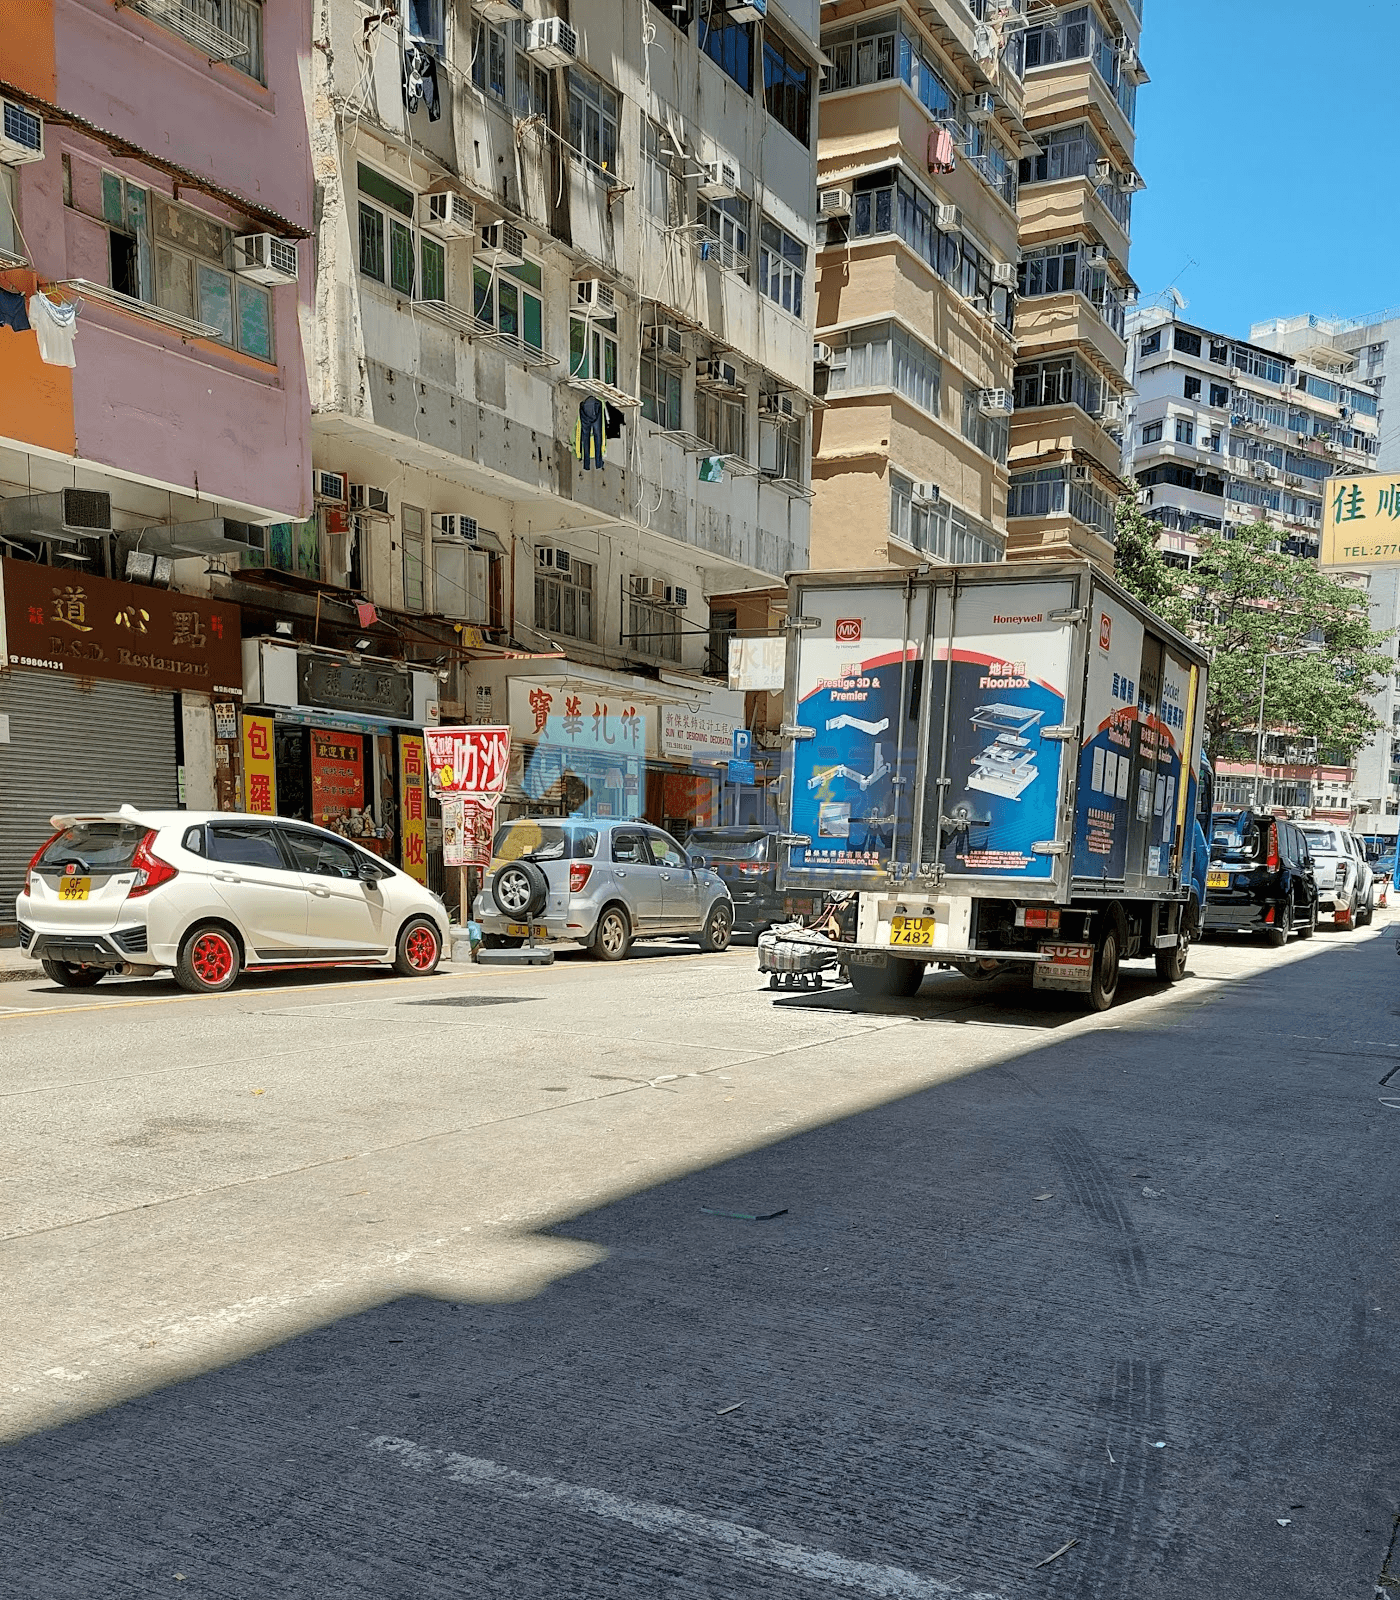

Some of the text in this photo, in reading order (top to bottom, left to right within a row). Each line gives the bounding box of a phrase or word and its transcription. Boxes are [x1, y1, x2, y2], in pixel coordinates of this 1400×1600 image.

[1344, 544, 1400, 556] TEL:277
[993, 614, 1043, 625] Honeywell
[20, 656, 64, 670] 59804131
[117, 647, 209, 677] Restaurant
[989, 661, 1026, 676] 地台箱
[817, 677, 880, 690] Prestige 3D &
[979, 677, 1030, 689] Floorbox
[830, 690, 868, 702] Premier
[665, 728, 675, 737] SUN
[686, 730, 708, 743] DESIGNING
[737, 732, 749, 757] P
[247, 721, 272, 813] 包羅
[453, 733, 508, 790] 叻沙
[403, 741, 425, 884] 高價收
[69, 878, 82, 889] GF
[64, 888, 84, 900] 992
[515, 926, 525, 934] JL
[904, 918, 923, 930] EU
[893, 931, 930, 944] 7482
[1040, 946, 1091, 959] ISUZU
